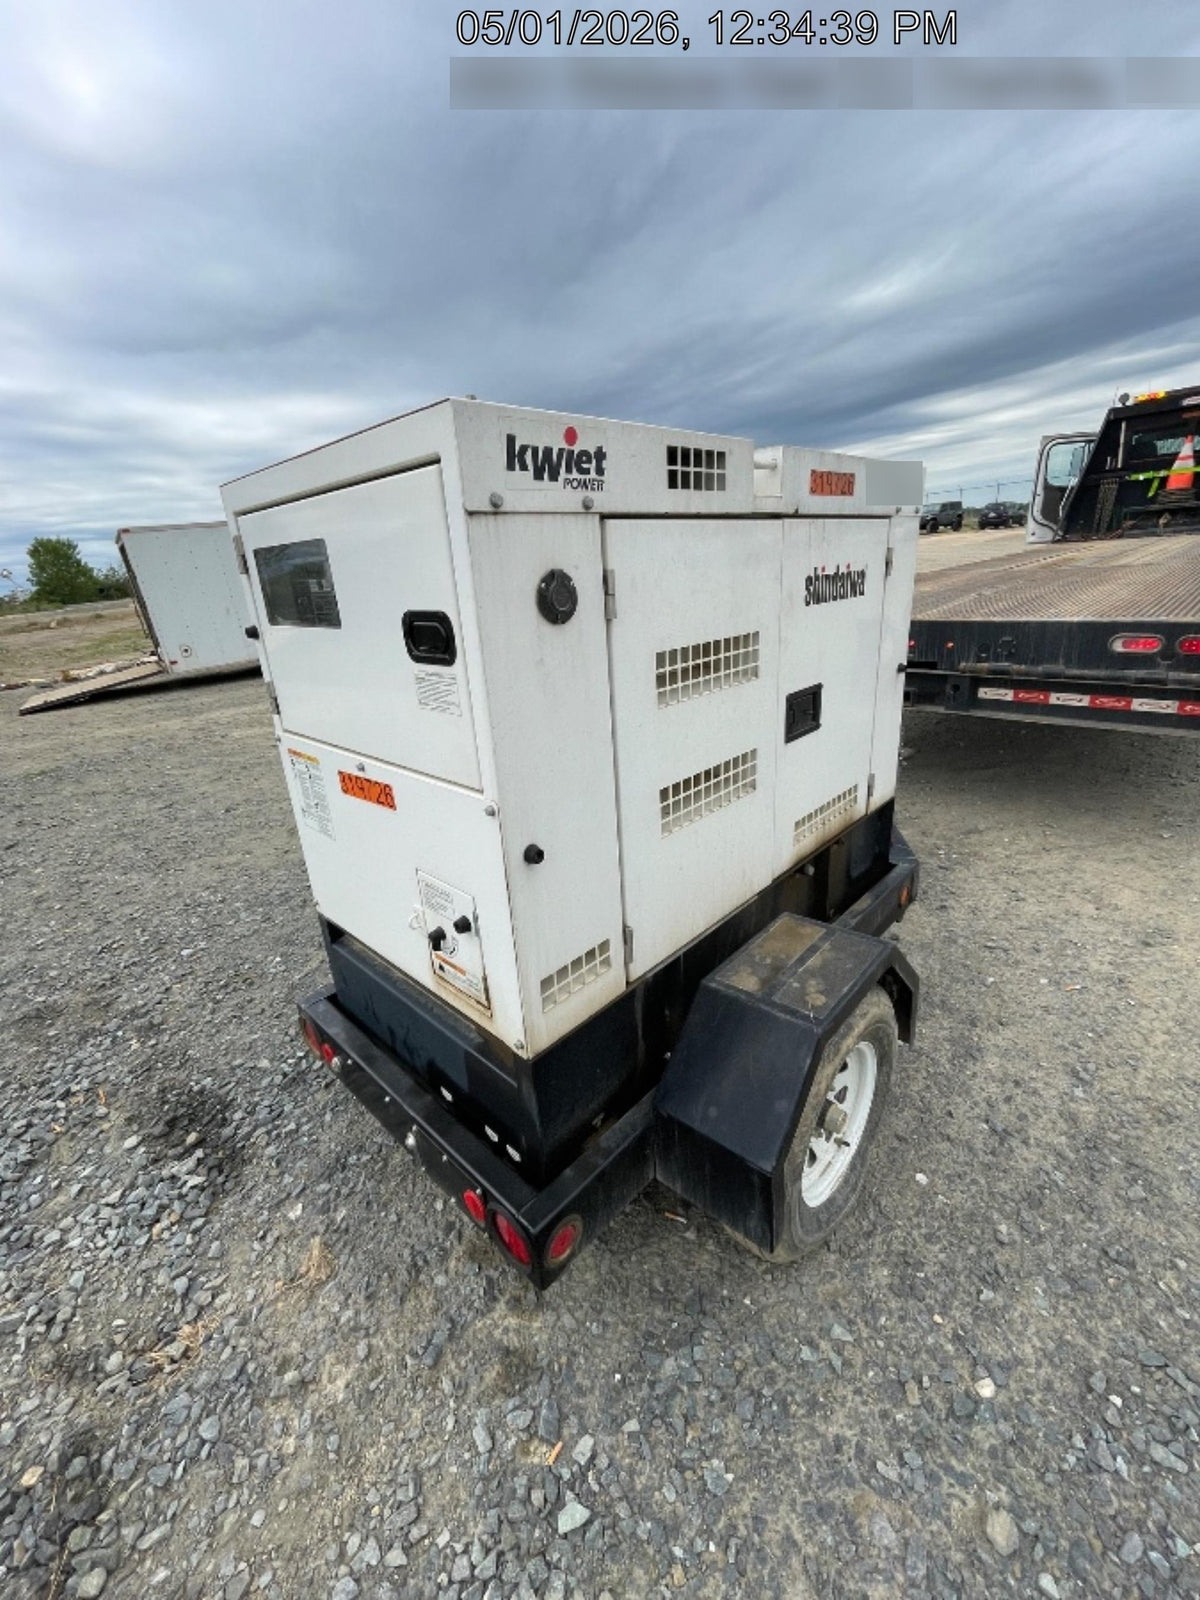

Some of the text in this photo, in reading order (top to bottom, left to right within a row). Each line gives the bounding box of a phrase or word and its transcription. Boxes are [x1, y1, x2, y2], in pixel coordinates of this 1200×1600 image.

[506, 426, 607, 483] kwiet
[562, 477, 605, 493] POWER
[804, 563, 866, 607] shindaiwa
